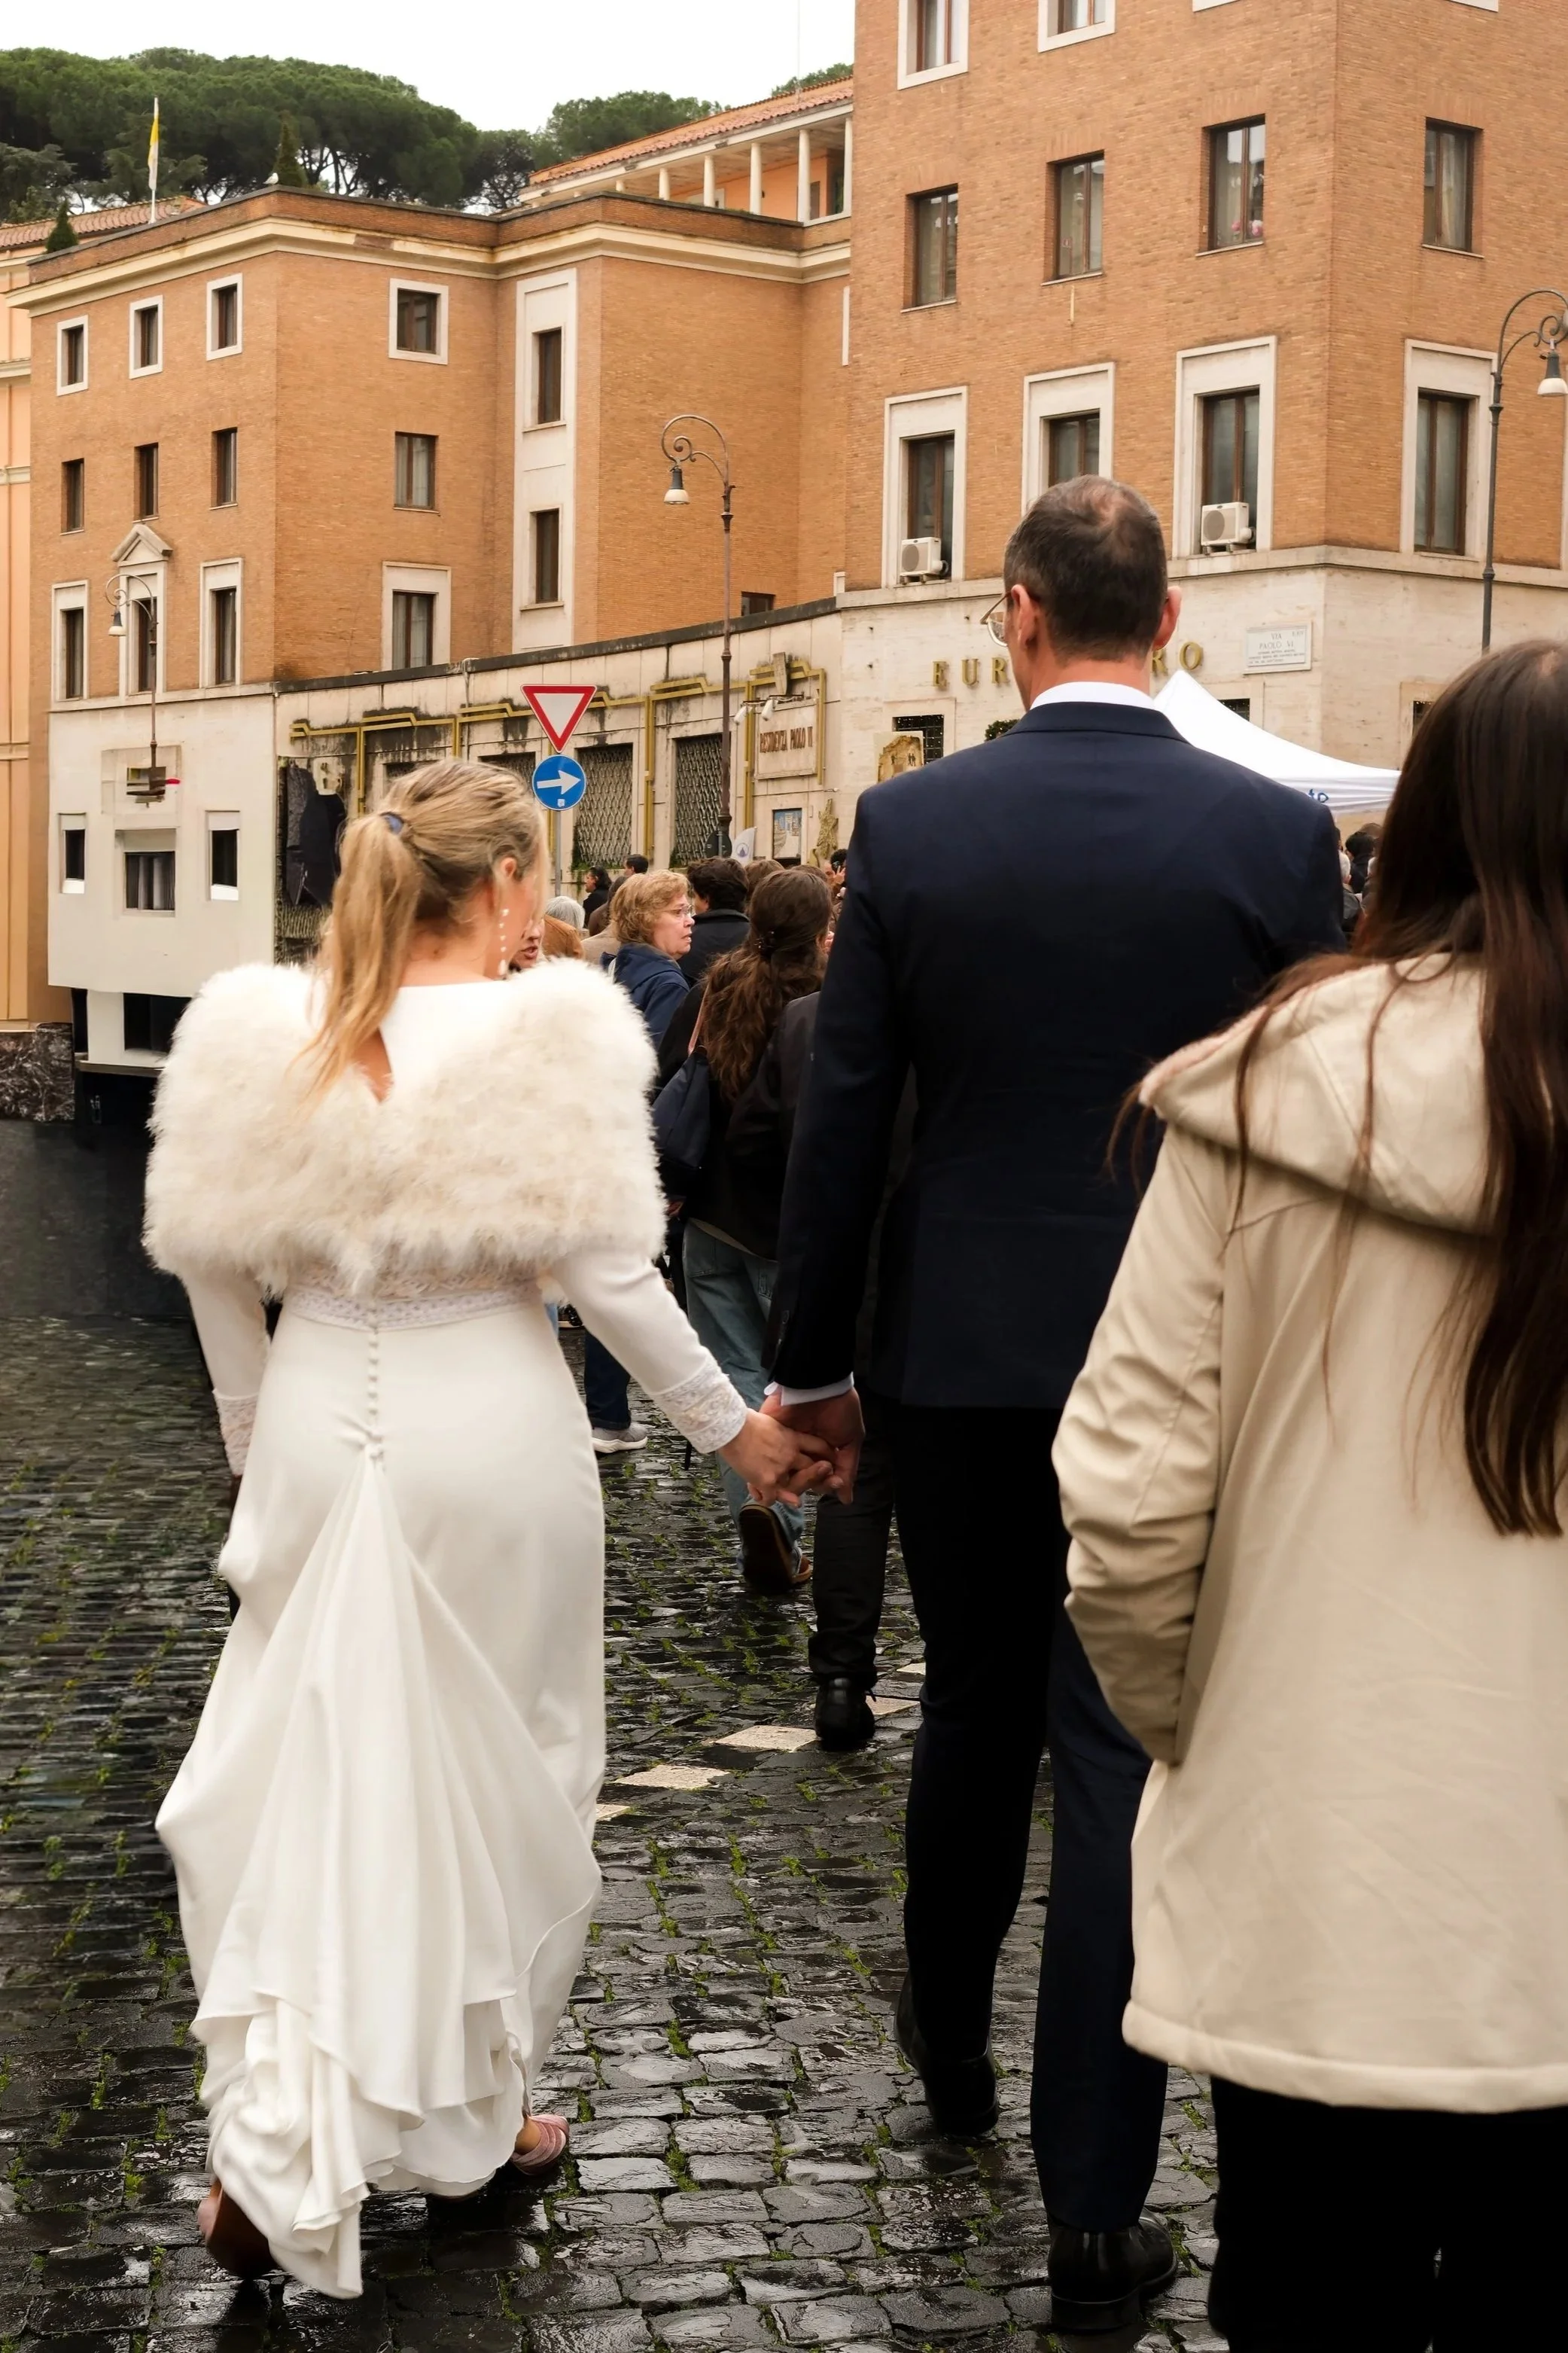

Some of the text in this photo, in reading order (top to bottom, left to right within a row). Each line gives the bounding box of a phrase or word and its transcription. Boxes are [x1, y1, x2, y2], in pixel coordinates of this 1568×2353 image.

[1271, 632, 1282, 640] VIA
[1259, 641, 1283, 649] PAOLO
[790, 727, 805, 749] PAOLO
